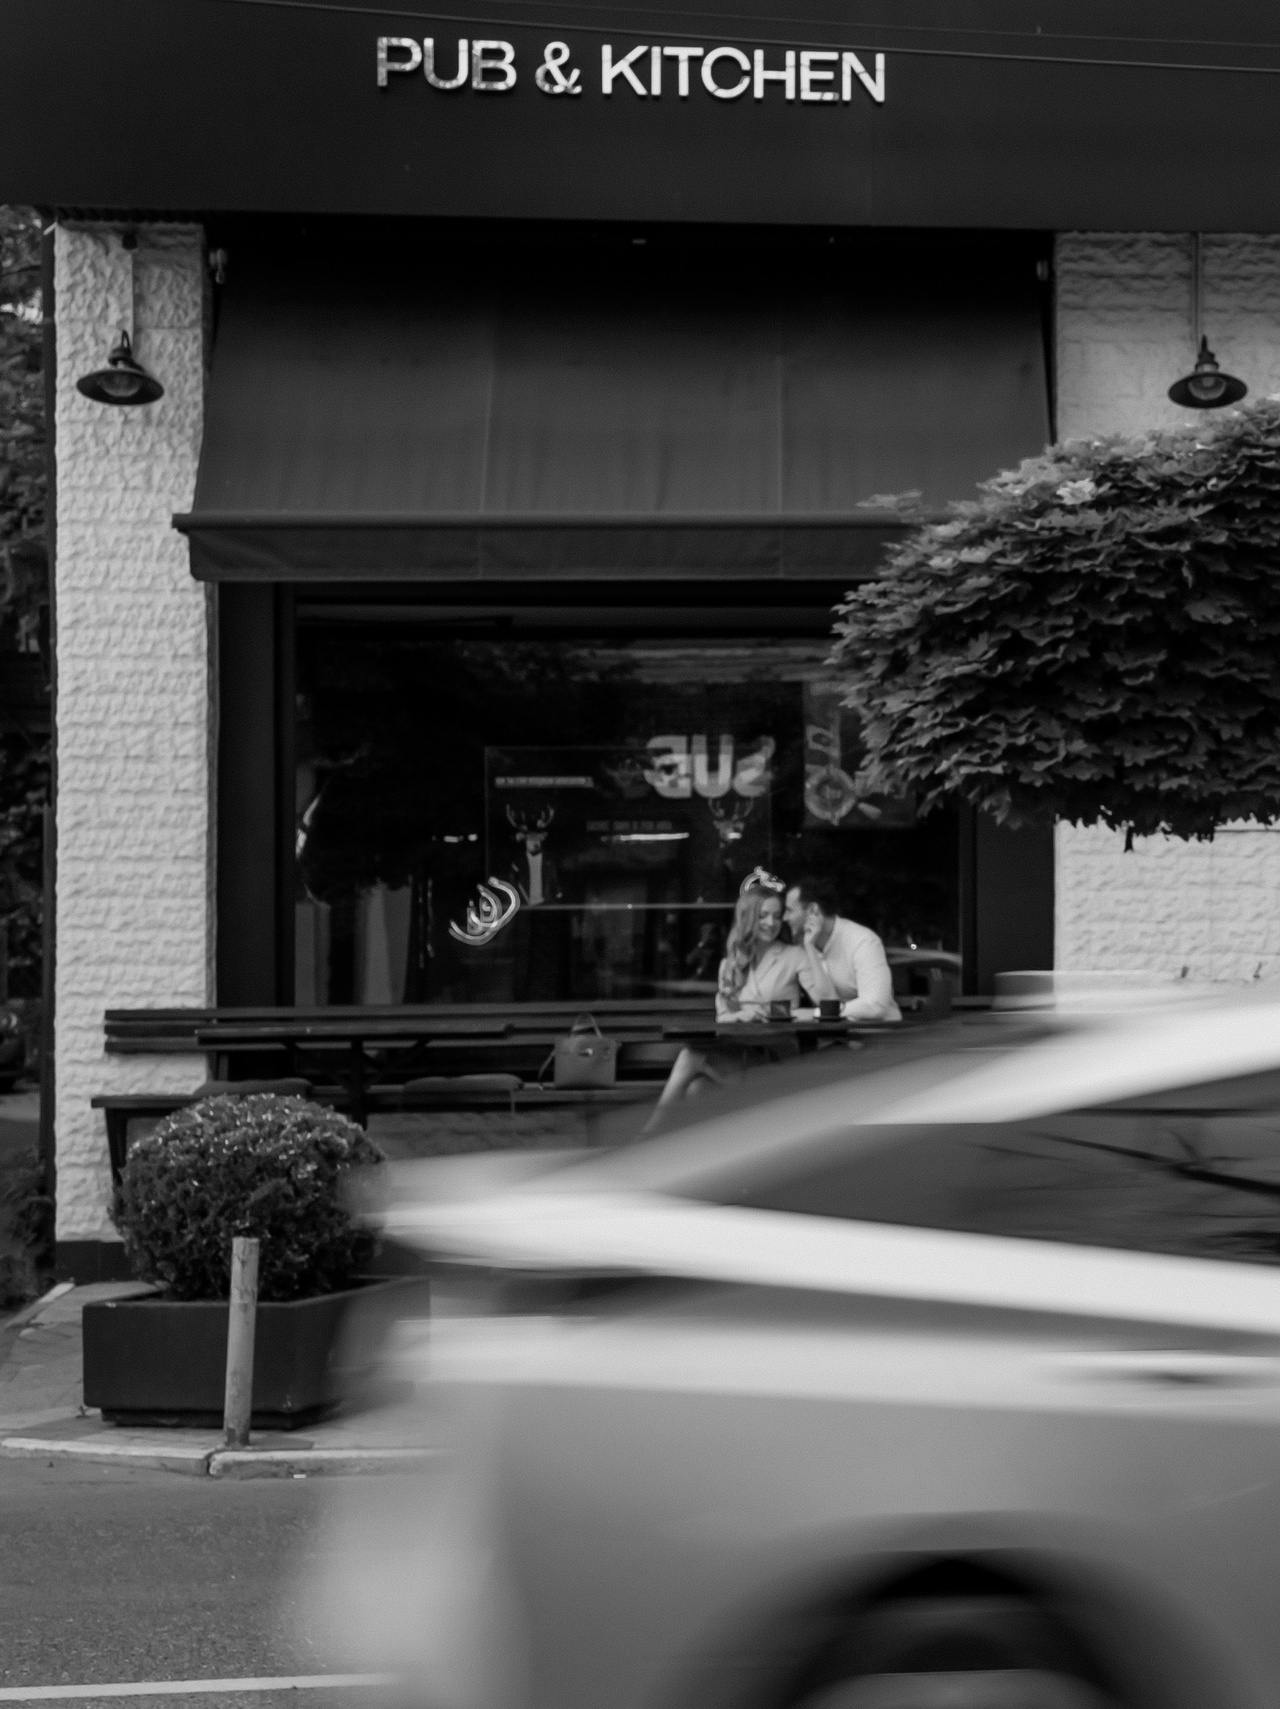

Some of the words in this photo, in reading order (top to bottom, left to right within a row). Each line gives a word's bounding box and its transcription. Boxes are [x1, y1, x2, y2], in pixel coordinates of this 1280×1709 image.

[376, 36, 518, 91] PUB
[534, 39, 583, 96] &
[600, 43, 886, 103] KITCHEN
